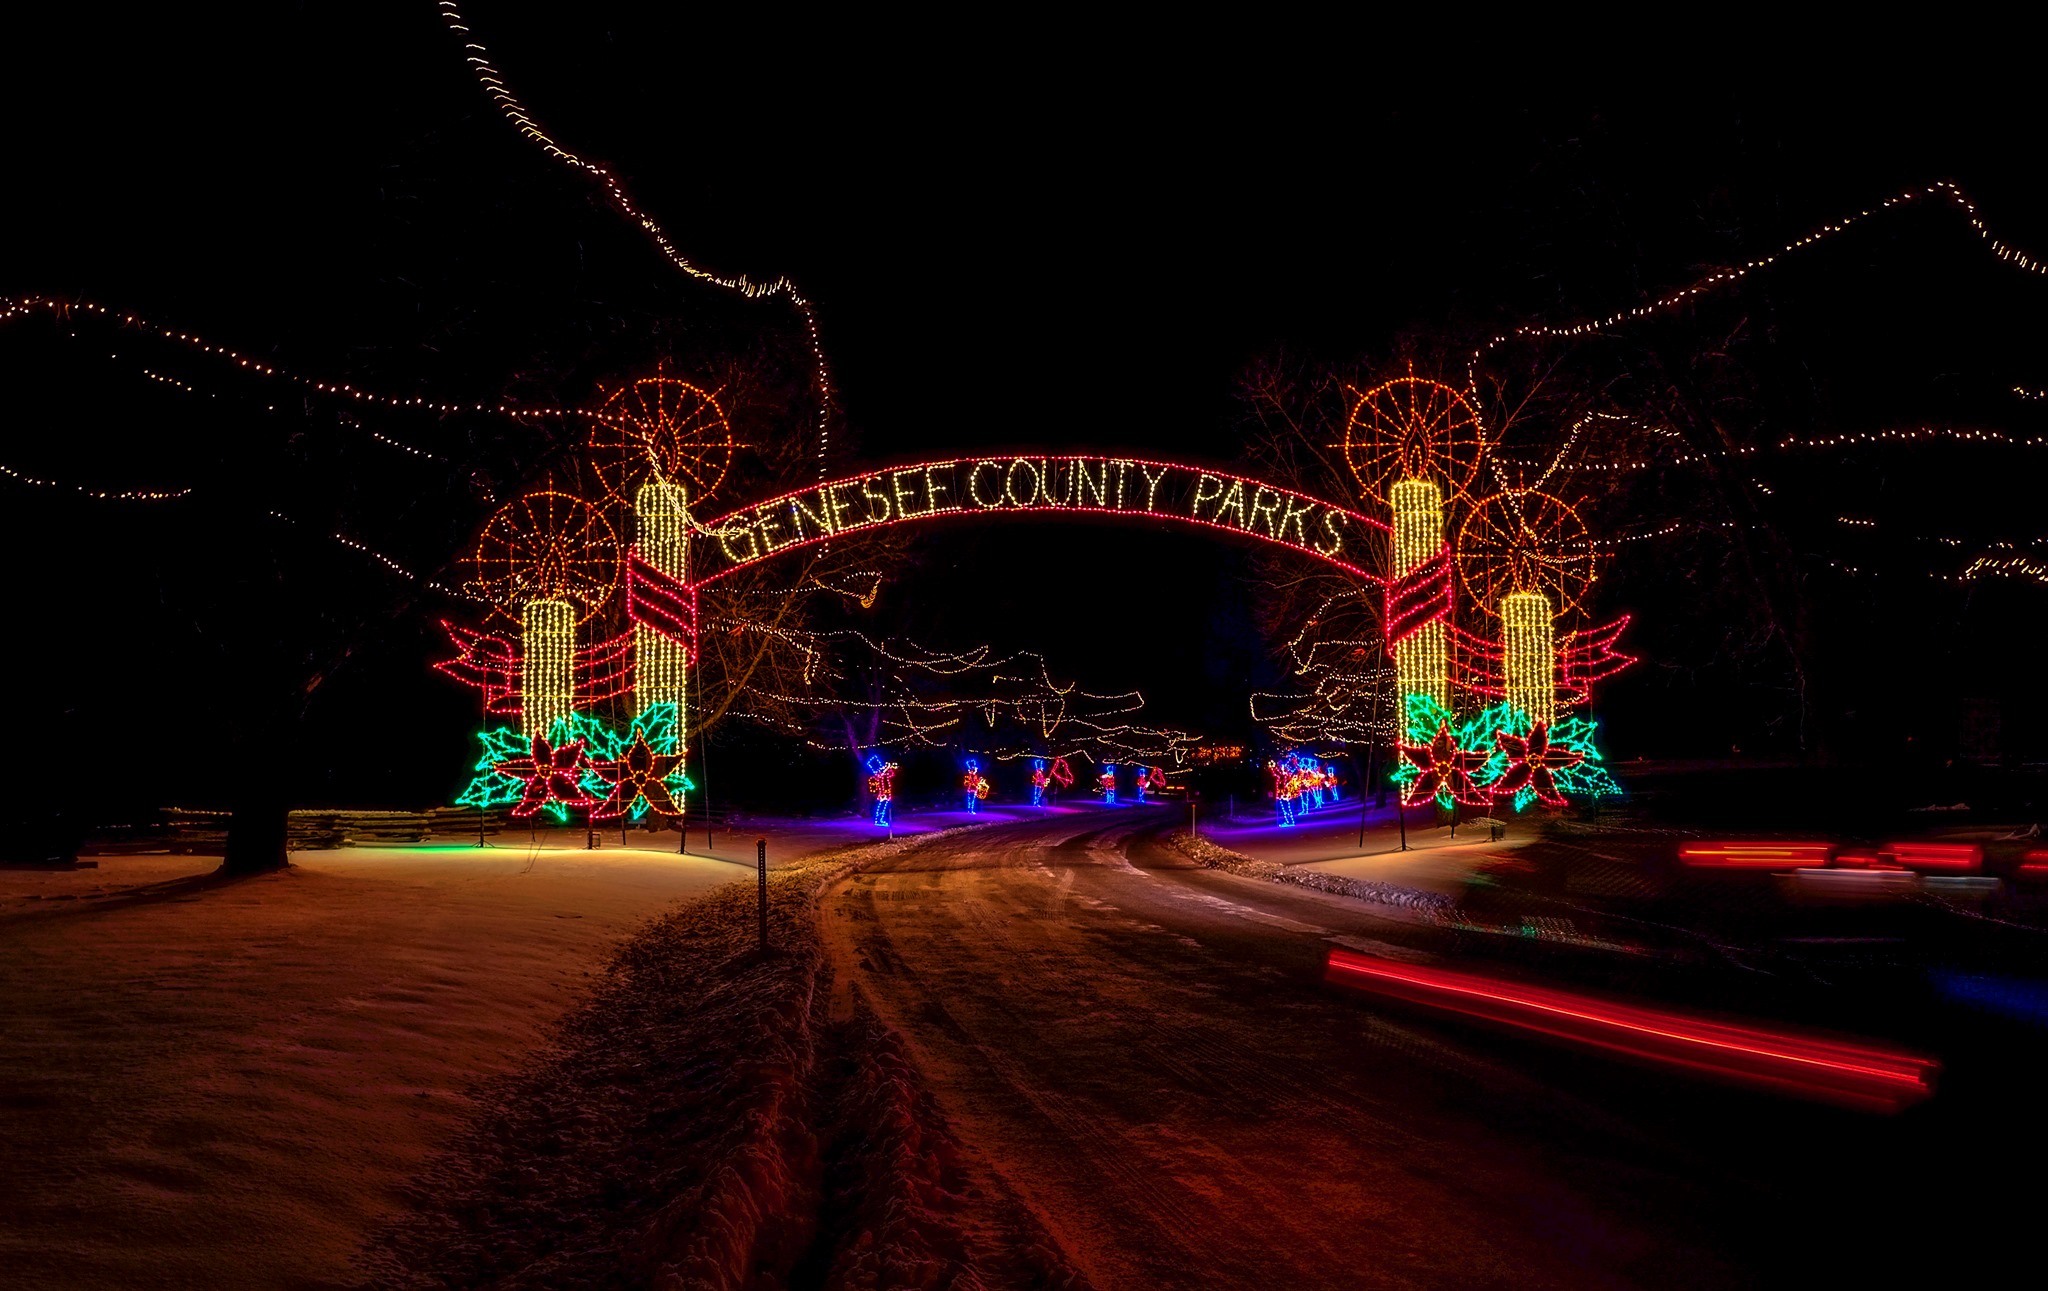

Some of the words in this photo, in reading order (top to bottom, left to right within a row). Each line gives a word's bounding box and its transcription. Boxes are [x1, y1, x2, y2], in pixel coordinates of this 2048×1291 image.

[720, 462, 962, 564] GENESEE
[969, 458, 1169, 511] COUNTY
[1192, 472, 1348, 557] PARKS
